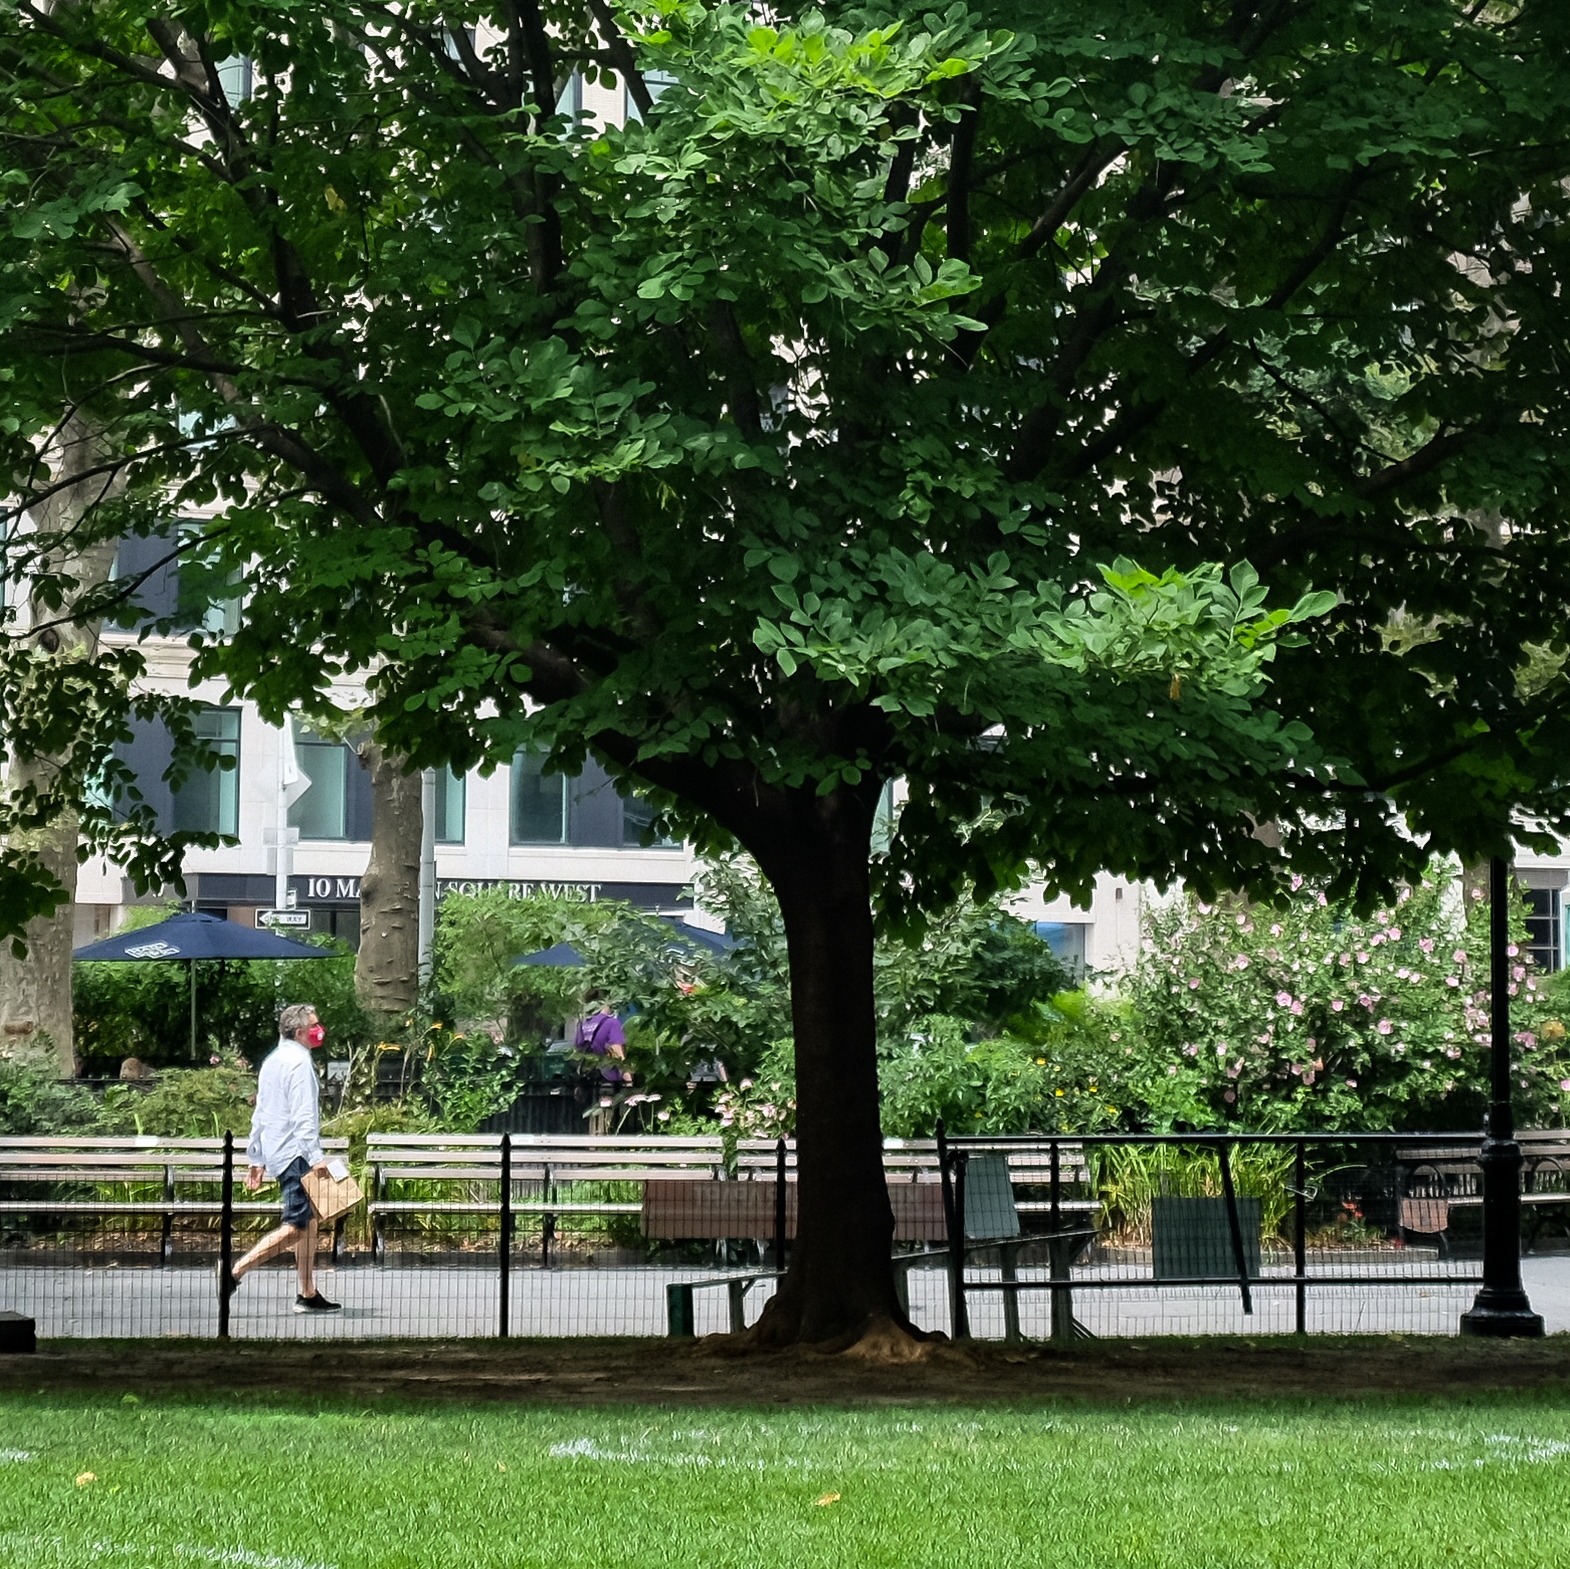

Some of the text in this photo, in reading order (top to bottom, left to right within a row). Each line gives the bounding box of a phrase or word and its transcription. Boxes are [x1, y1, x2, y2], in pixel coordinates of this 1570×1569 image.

[307, 878, 331, 898] 10
[447, 881, 536, 901] SQURE
[540, 883, 602, 903] WEST
